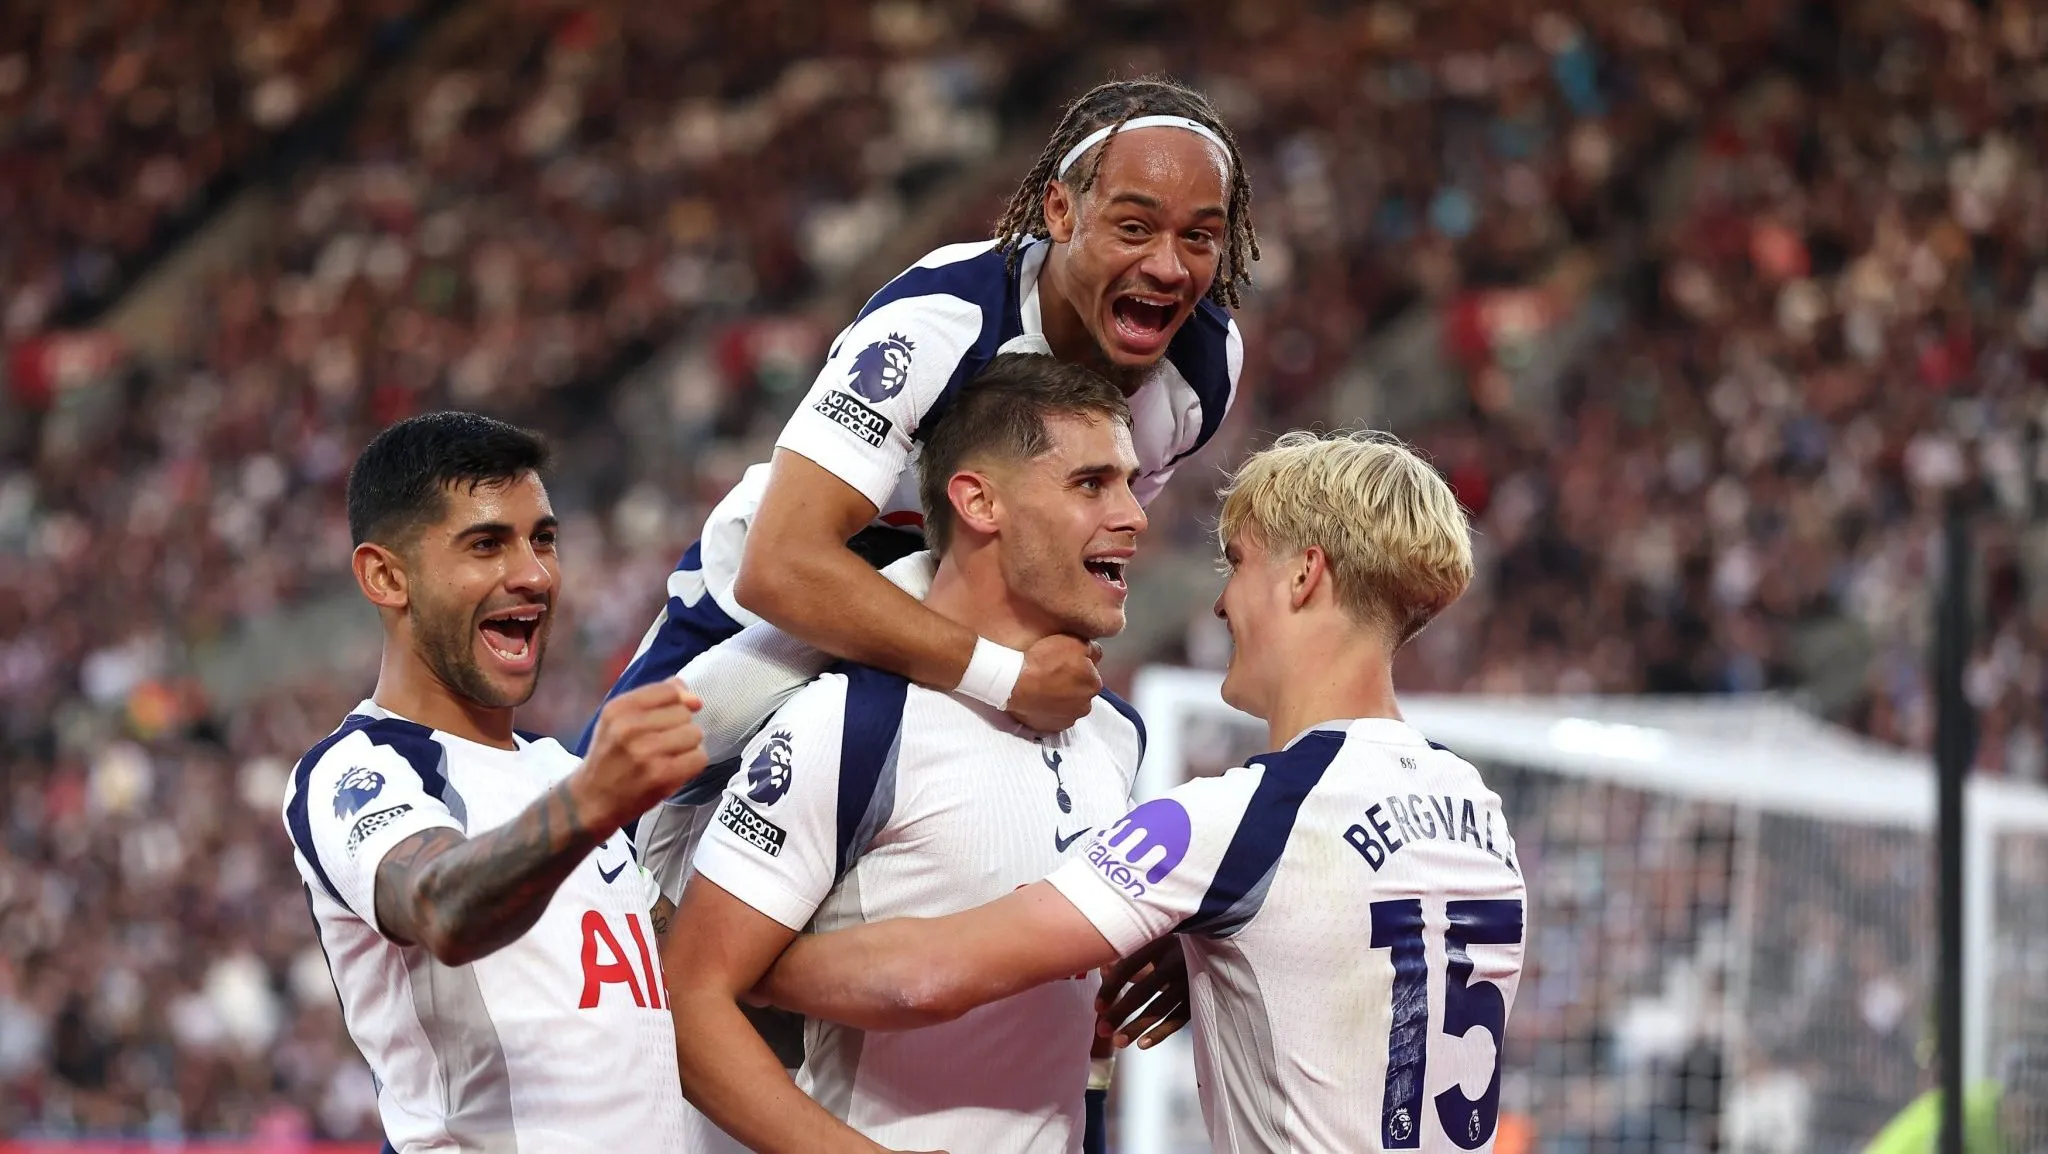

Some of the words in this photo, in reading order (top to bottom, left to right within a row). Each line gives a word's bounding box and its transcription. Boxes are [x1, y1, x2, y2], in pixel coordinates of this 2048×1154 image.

[822, 391, 844, 409] No
[842, 399, 885, 432] room
[834, 409, 884, 448] racism
[358, 807, 405, 831] room
[725, 798, 743, 815] No
[740, 808, 778, 841] room
[733, 820, 780, 857] racism
[1083, 840, 1145, 898] raken
[579, 910, 671, 1010] AI
[1370, 899, 1523, 1150] 15
